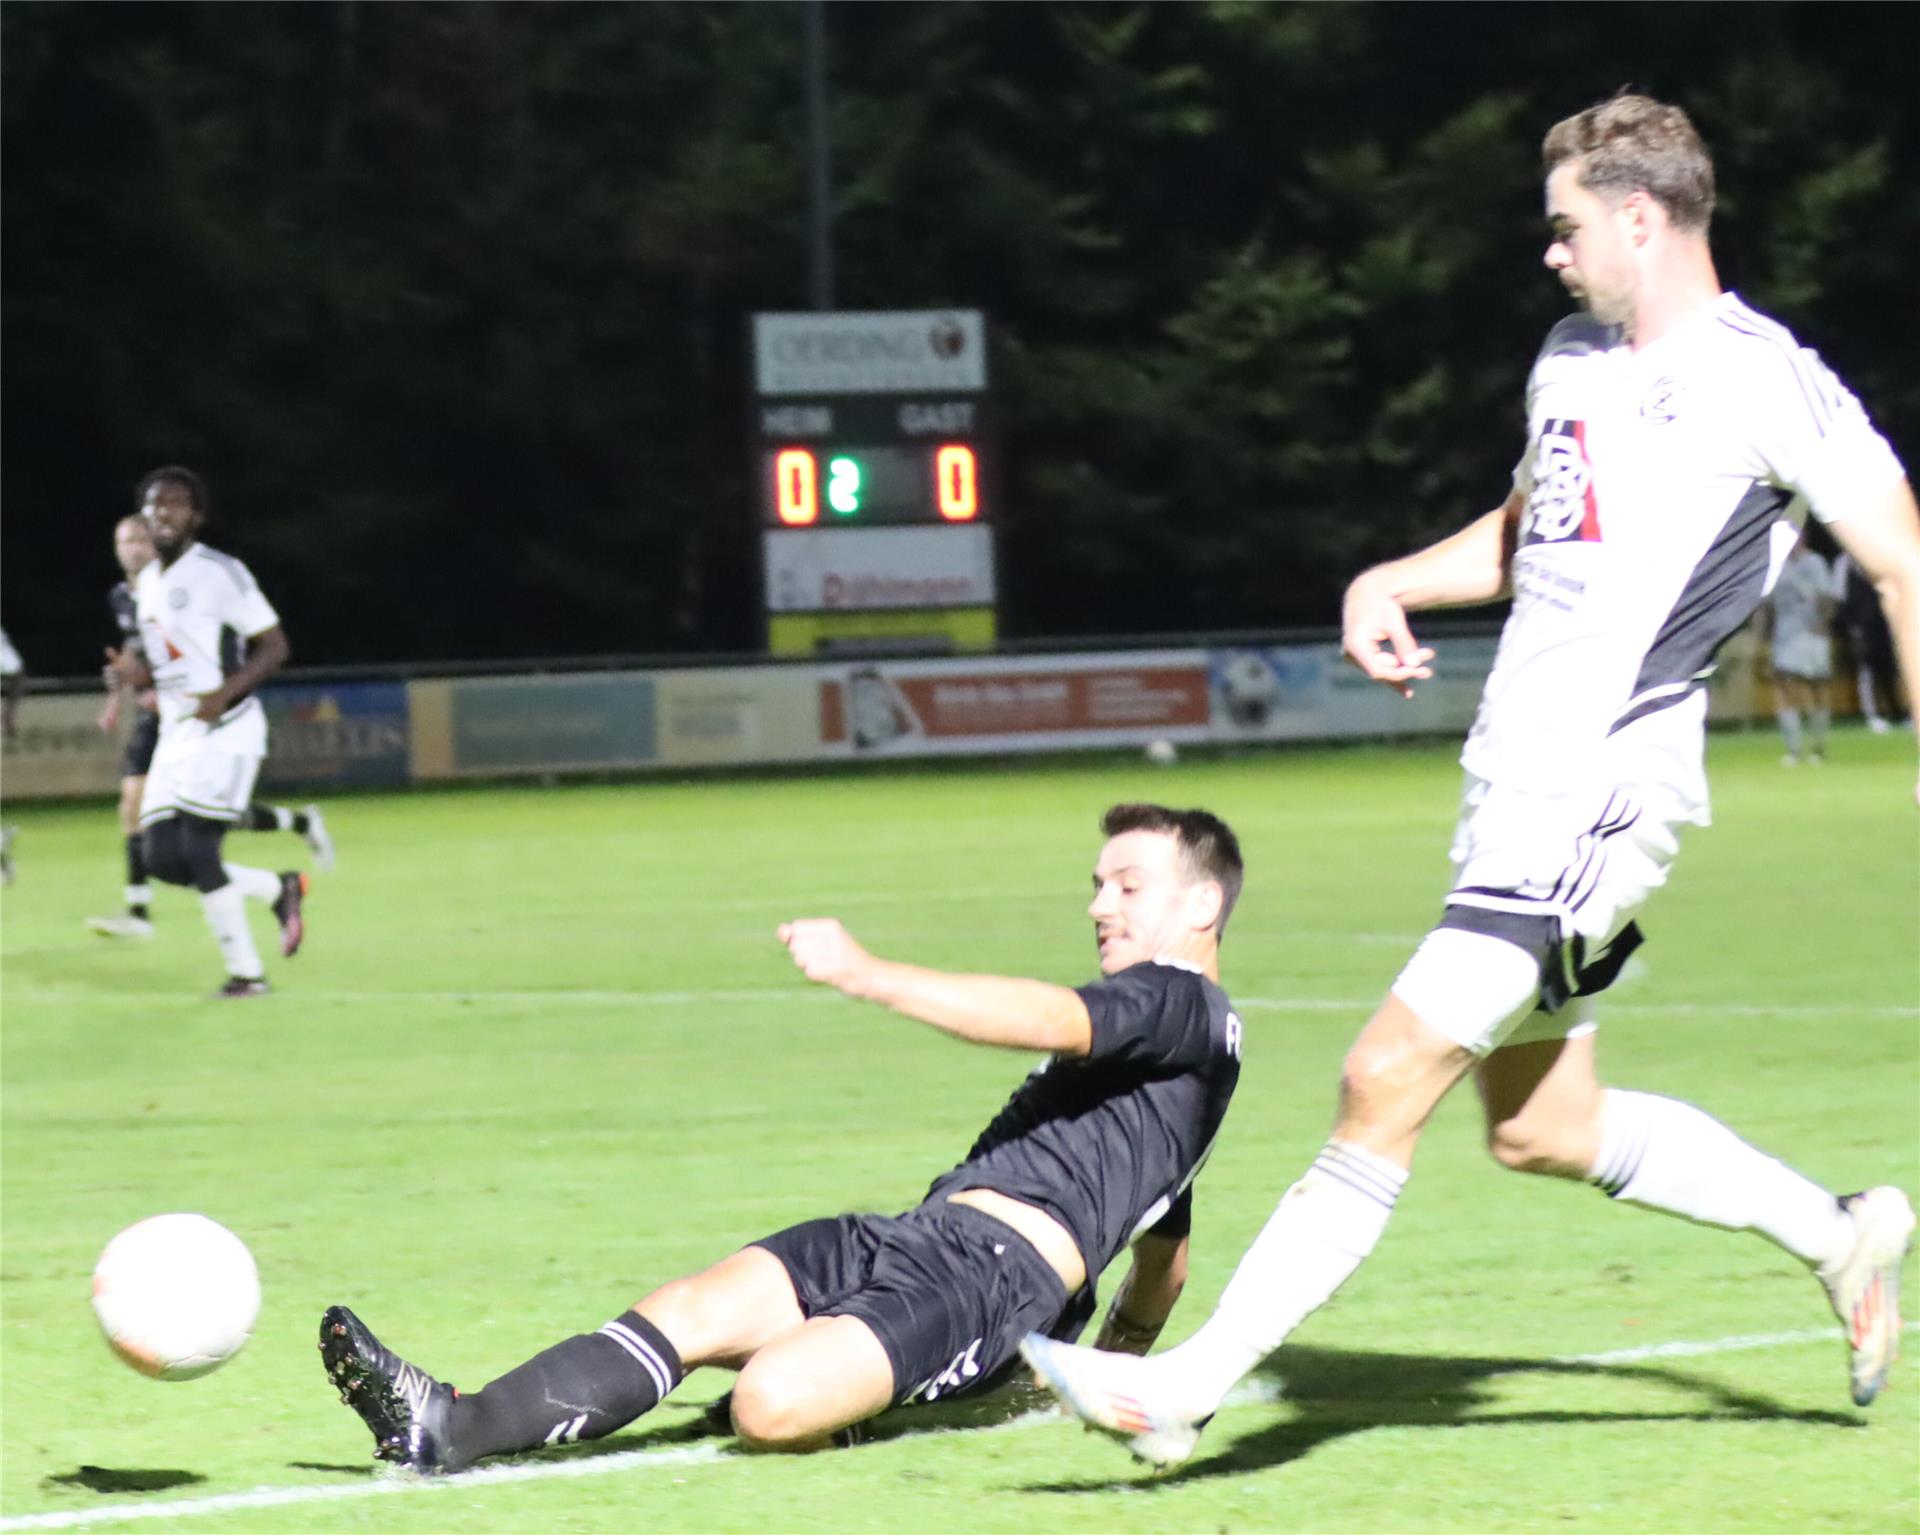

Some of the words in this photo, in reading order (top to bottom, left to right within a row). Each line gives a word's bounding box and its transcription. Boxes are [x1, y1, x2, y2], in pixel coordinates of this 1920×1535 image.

[898, 402, 975, 434] GAST
[777, 448, 818, 525] 0
[828, 456, 861, 514] 2
[936, 445, 978, 521] 0
